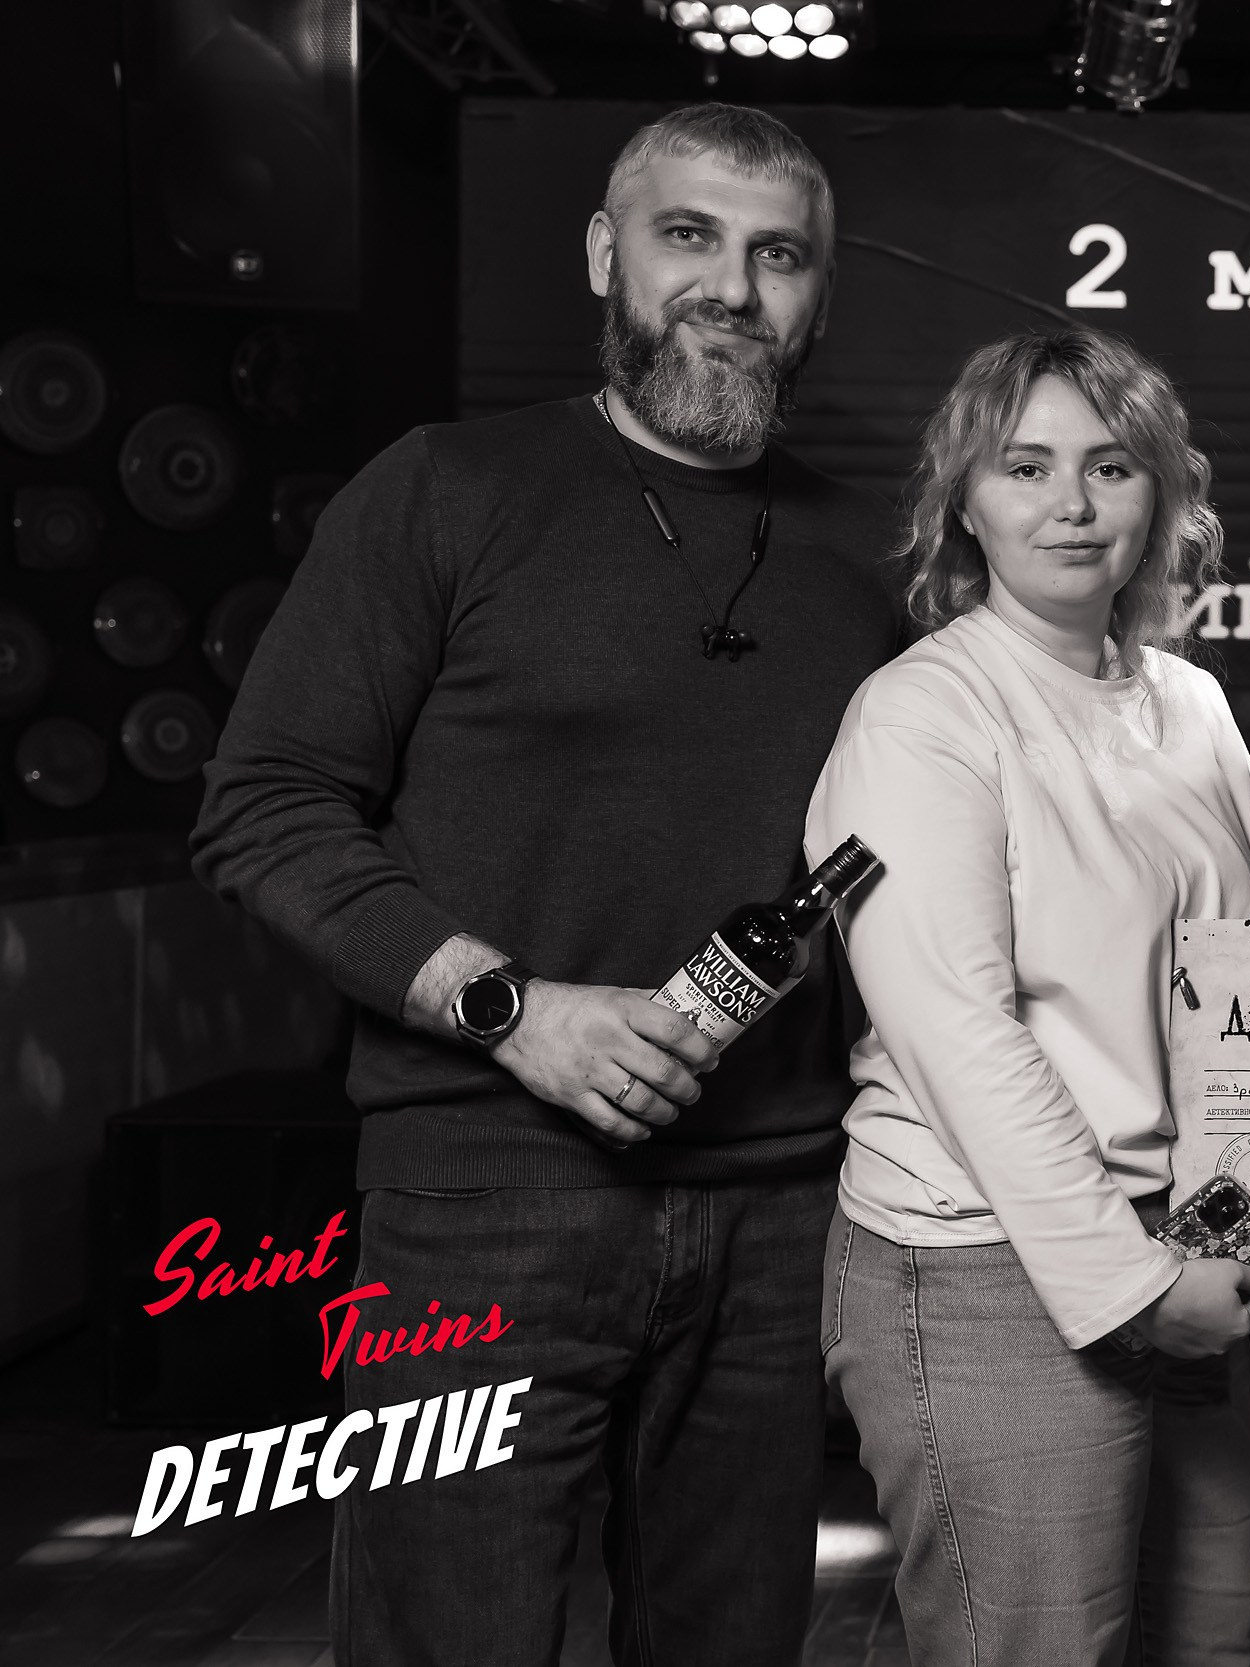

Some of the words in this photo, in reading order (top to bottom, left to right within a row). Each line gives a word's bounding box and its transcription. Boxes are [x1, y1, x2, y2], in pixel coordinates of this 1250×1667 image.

[1065, 223, 1128, 309] 2
[660, 986, 681, 1012] SUPER
[686, 954, 757, 1024] LAWSON'S
[701, 943, 766, 1009] WILLIAM
[686, 983, 708, 1003] SPIRIT
[706, 1002, 727, 1023] DRINK
[1206, 1084, 1229, 1093] ДЕЛО:
